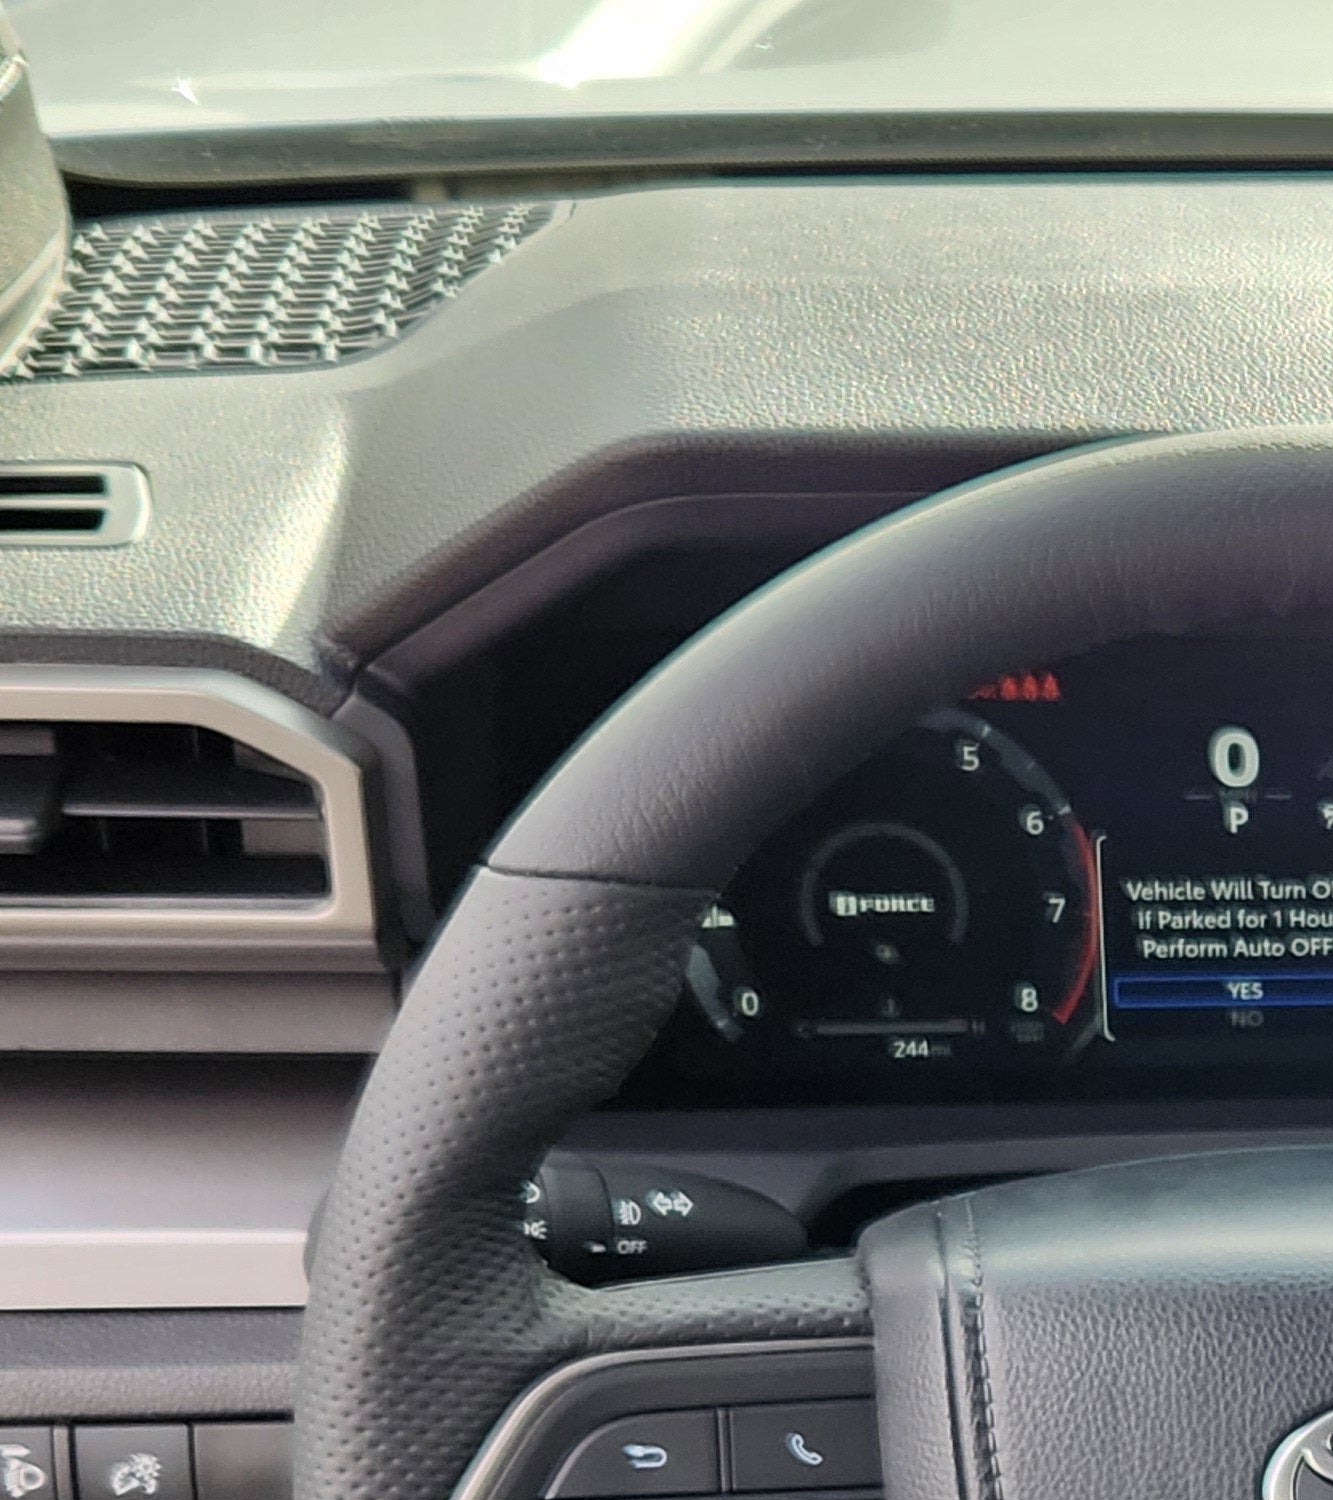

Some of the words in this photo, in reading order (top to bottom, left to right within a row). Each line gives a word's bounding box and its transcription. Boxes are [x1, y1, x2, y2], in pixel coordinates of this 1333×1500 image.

[961, 746, 980, 772] 5
[1026, 811, 1044, 836] 6
[1229, 806, 1249, 834] P
[1126, 880, 1206, 901] Vehicle
[1211, 880, 1253, 901] Will
[1258, 880, 1306, 900] Turn
[1048, 898, 1067, 923] 7
[1158, 909, 1232, 930] Parked
[1237, 908, 1266, 928] for
[1272, 910, 1283, 928] 1
[1142, 937, 1228, 959] Perform
[1233, 938, 1285, 958] Auto
[1019, 987, 1039, 1012] 8
[1227, 982, 1264, 1000] YES
[739, 992, 760, 1016] 0
[1231, 1010, 1265, 1027] NO
[893, 1040, 930, 1058] 244
[617, 1240, 648, 1255] OFF
